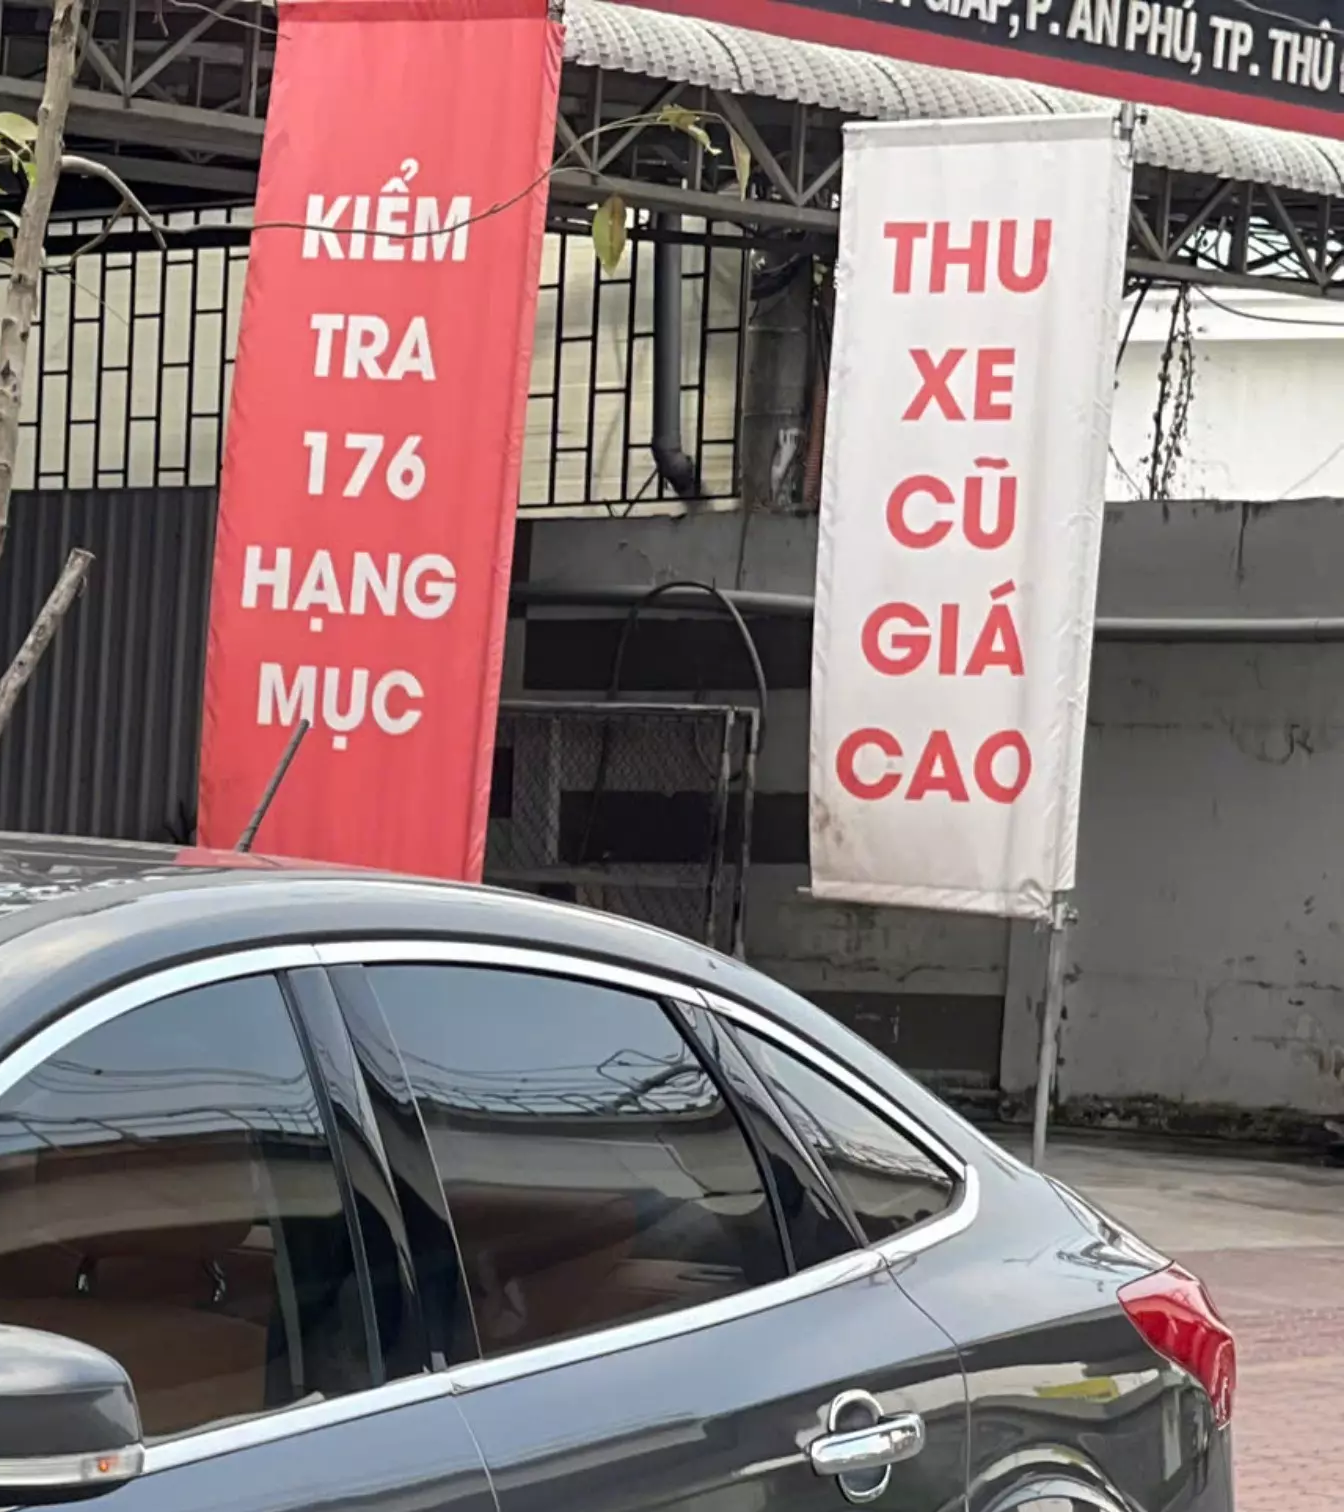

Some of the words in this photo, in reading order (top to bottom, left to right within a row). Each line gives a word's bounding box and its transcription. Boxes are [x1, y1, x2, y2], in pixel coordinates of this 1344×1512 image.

[1209, 15, 1261, 77] TP.
[301, 157, 472, 262] KIỂM
[883, 219, 1053, 294] THU
[310, 314, 437, 381] TRA
[901, 348, 1017, 421] XE
[303, 431, 427, 501] 176
[885, 458, 1018, 549] CŨ
[241, 545, 458, 632] HẠNG
[860, 580, 1026, 676] GIÁ
[256, 663, 425, 750] MỤC
[835, 727, 1033, 803] CAO
